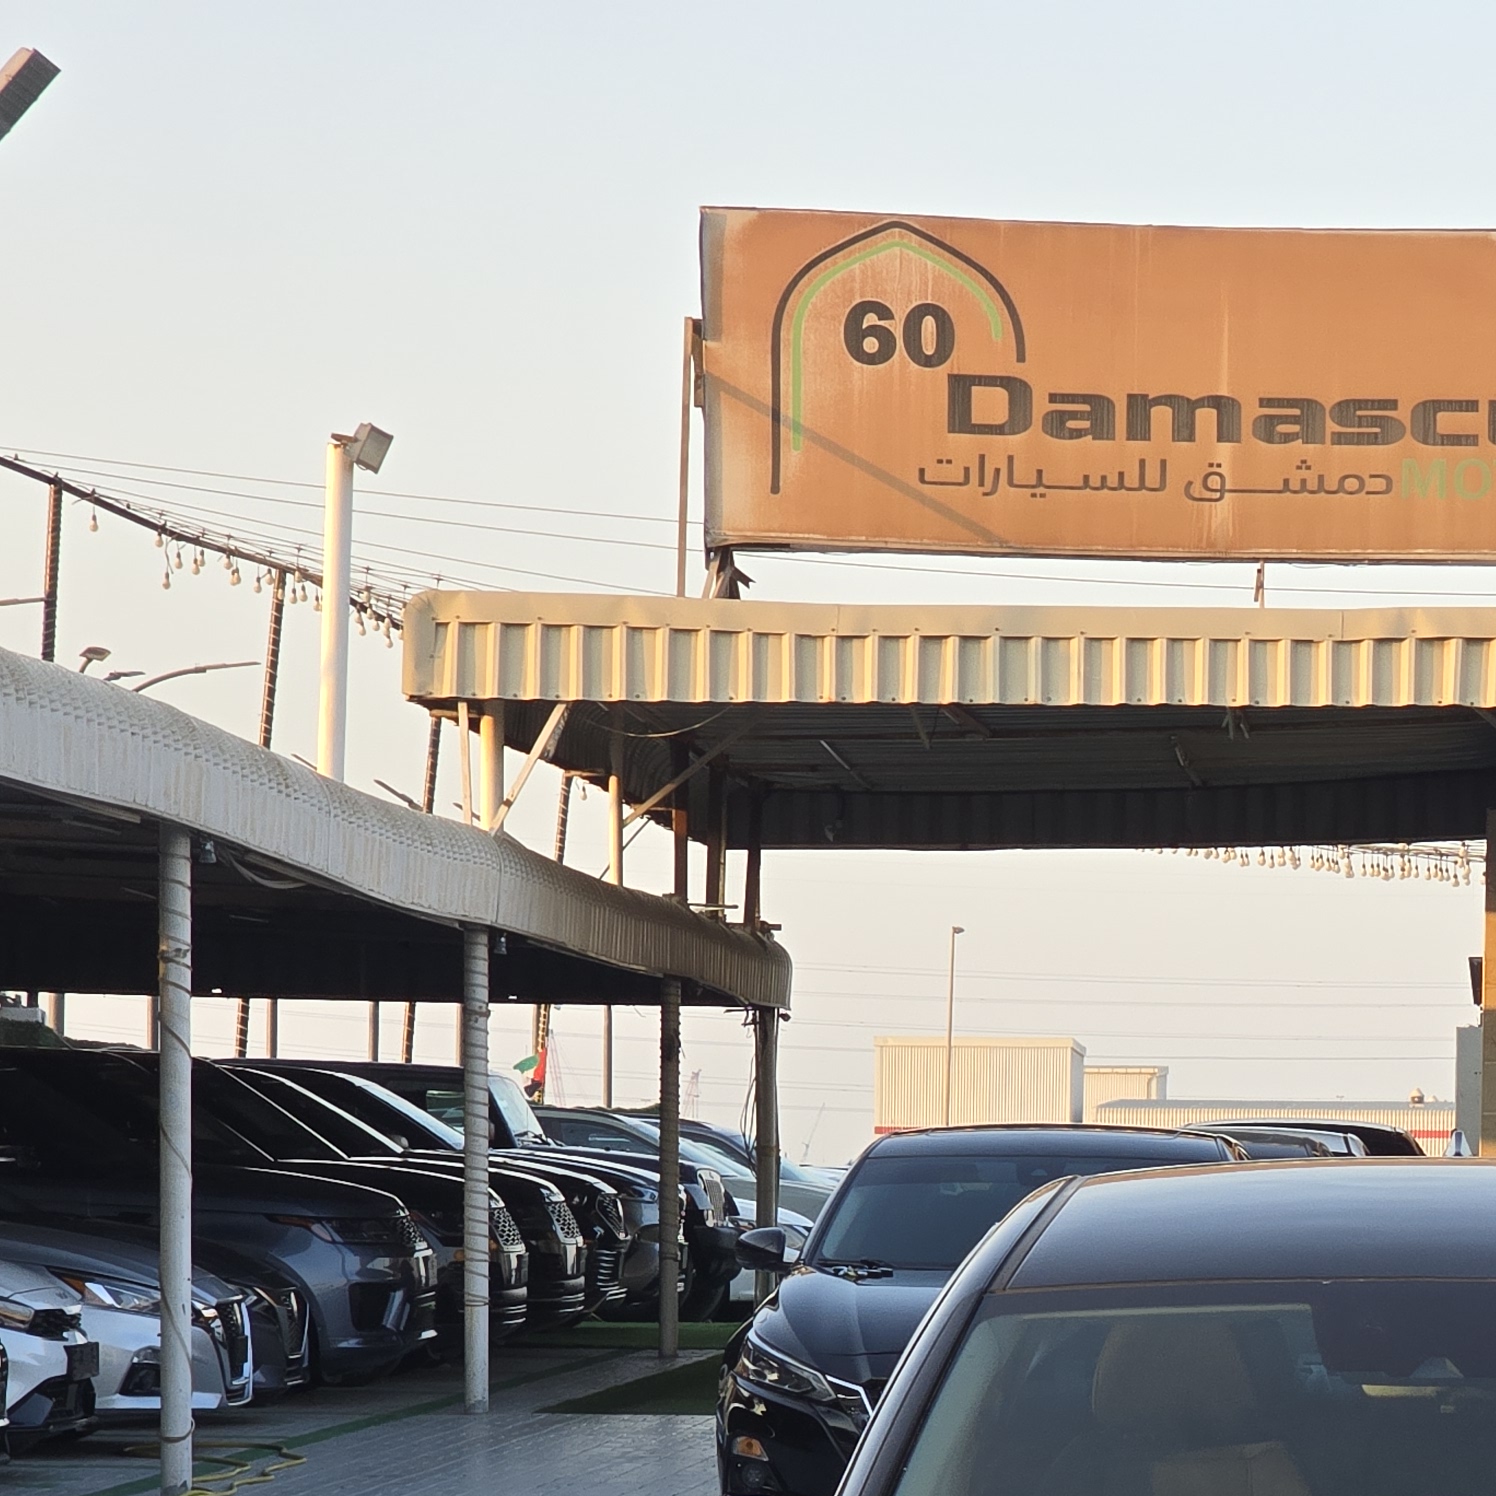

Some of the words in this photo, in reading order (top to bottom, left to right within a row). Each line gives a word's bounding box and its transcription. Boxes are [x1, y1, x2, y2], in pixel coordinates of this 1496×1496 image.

[843, 299, 956, 369] 60
[917, 453, 1168, 499] للسيارات
[1183, 458, 1395, 503] دمشق
